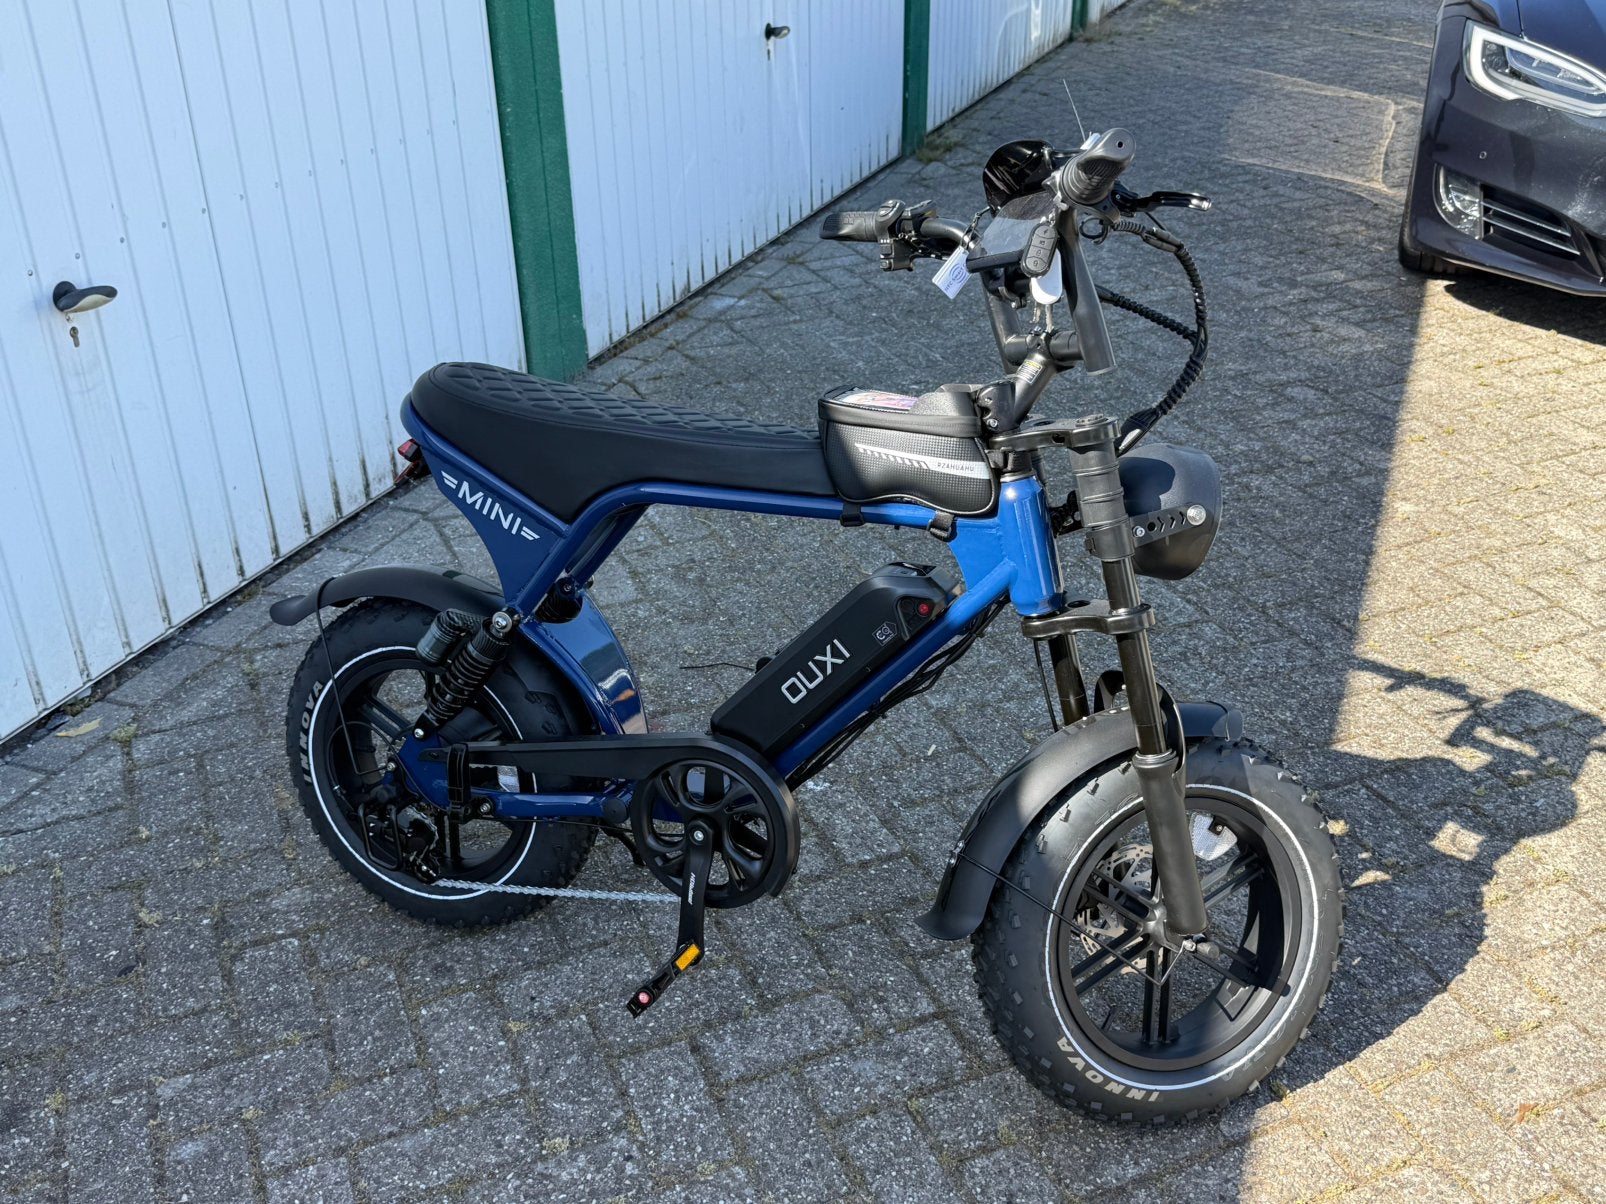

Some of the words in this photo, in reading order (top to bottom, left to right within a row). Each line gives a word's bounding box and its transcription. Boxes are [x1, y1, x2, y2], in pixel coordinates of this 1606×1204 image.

[457, 480, 522, 535] MINI
[781, 638, 851, 704] OUXI
[299, 680, 324, 784] INNOVA
[1056, 1036, 1160, 1102] INNOVA
